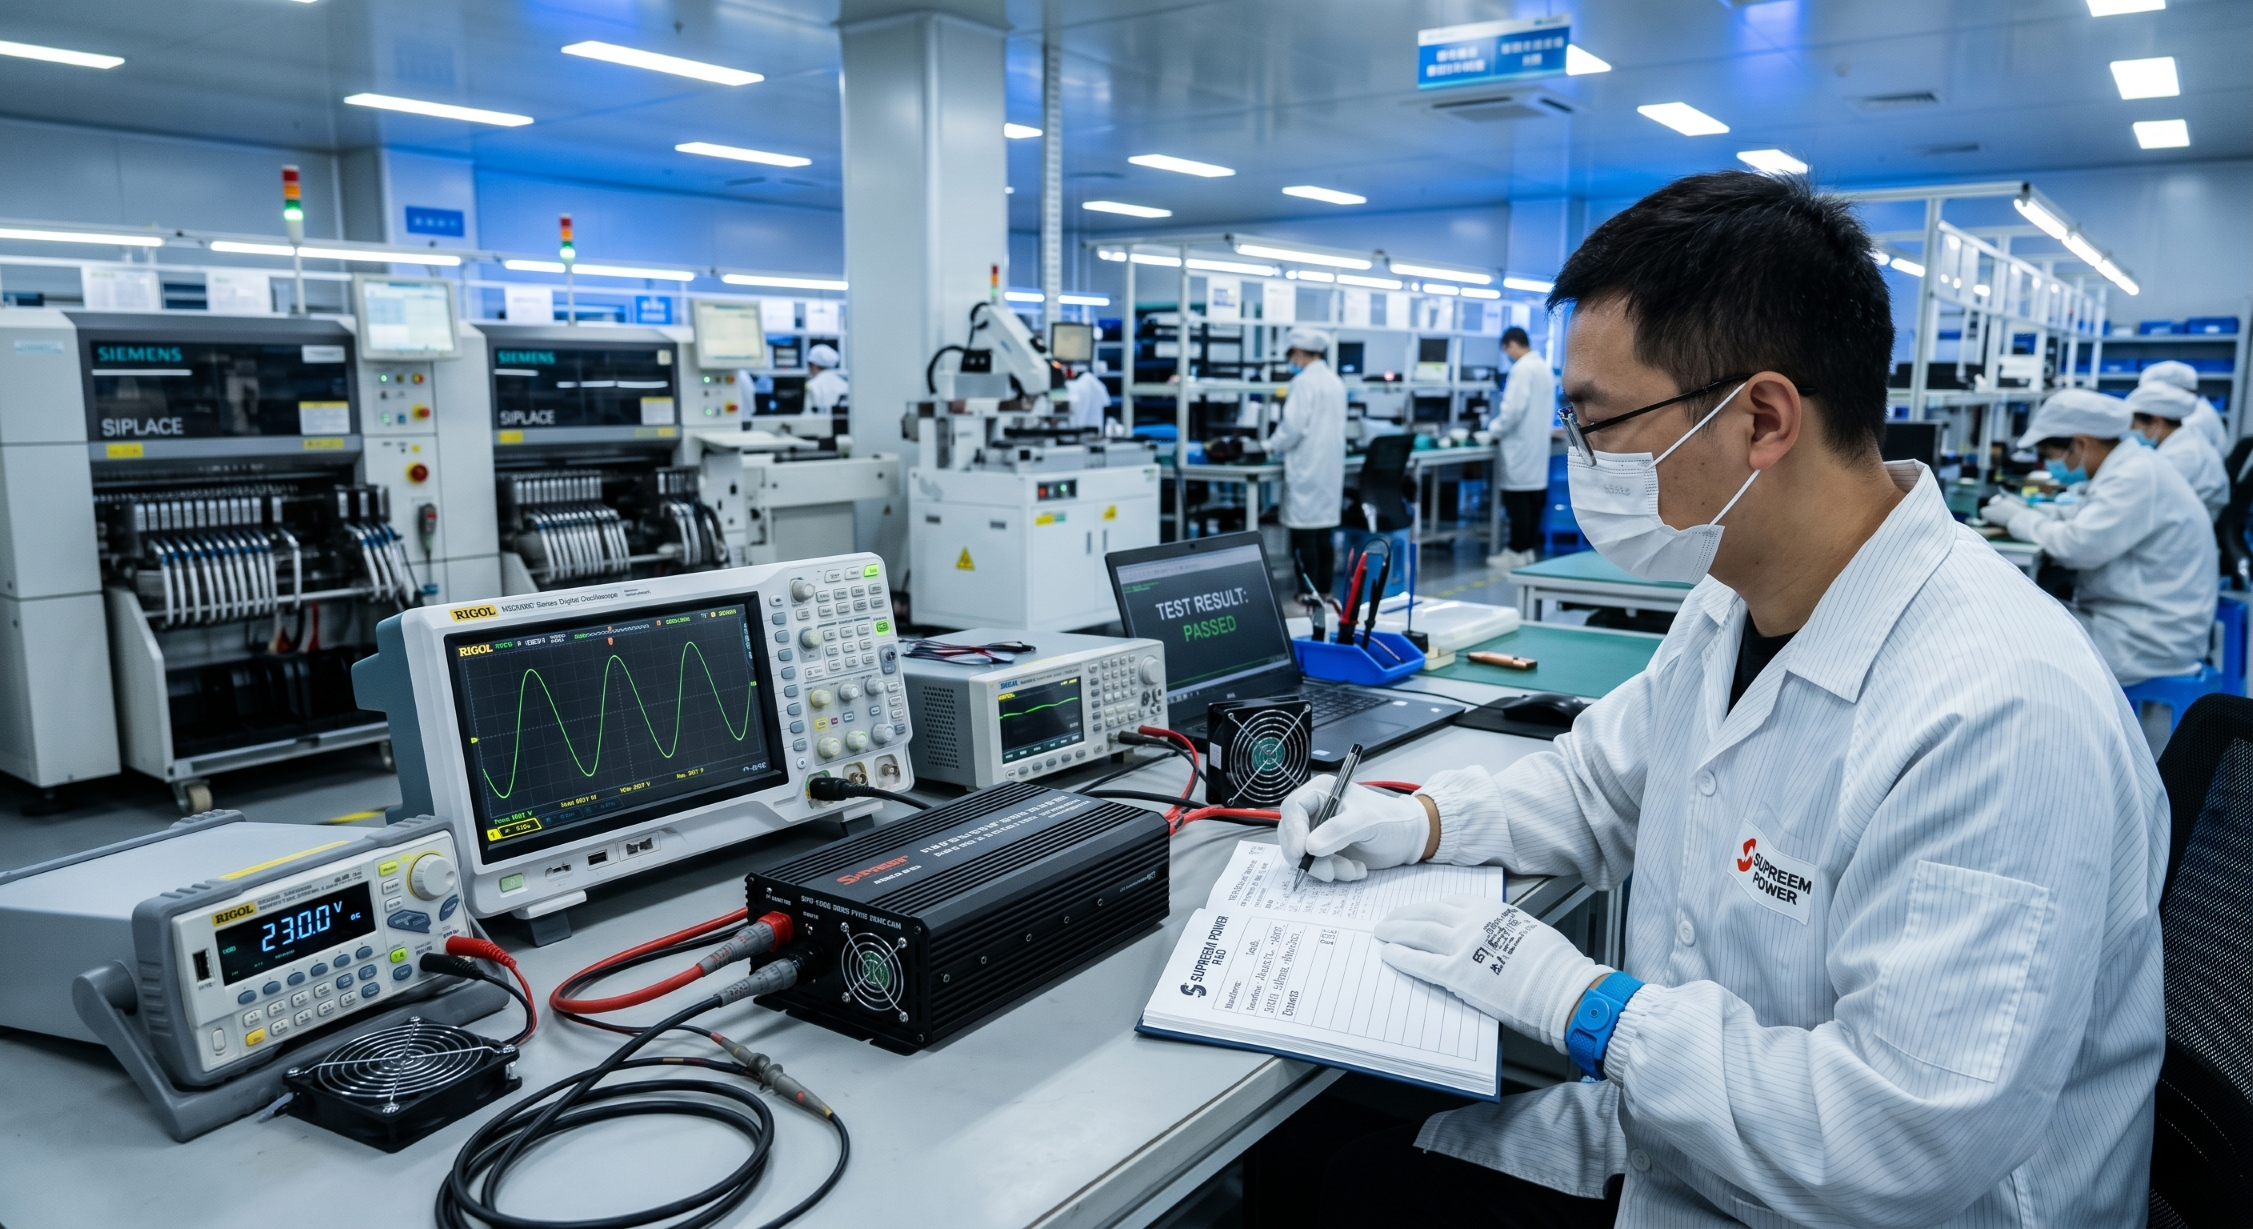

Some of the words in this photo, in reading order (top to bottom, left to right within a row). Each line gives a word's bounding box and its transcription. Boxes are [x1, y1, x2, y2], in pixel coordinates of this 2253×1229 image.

[98, 346, 182, 362] SIEMENS
[498, 350, 555, 365] SIEMENS
[500, 409, 555, 425] SIPLACE
[102, 417, 184, 437] SIPLACE
[1156, 597, 1191, 621] TEST
[1193, 587, 1248, 613] RESULT:
[454, 606, 496, 620] RIGOL
[1183, 615, 1237, 642] PASSED
[459, 644, 493, 657] RIGOL
[1753, 853, 1812, 894] SUPREEM
[1753, 872, 1797, 905] POWER
[215, 905, 254, 924] RIGOL
[333, 901, 342, 913] V
